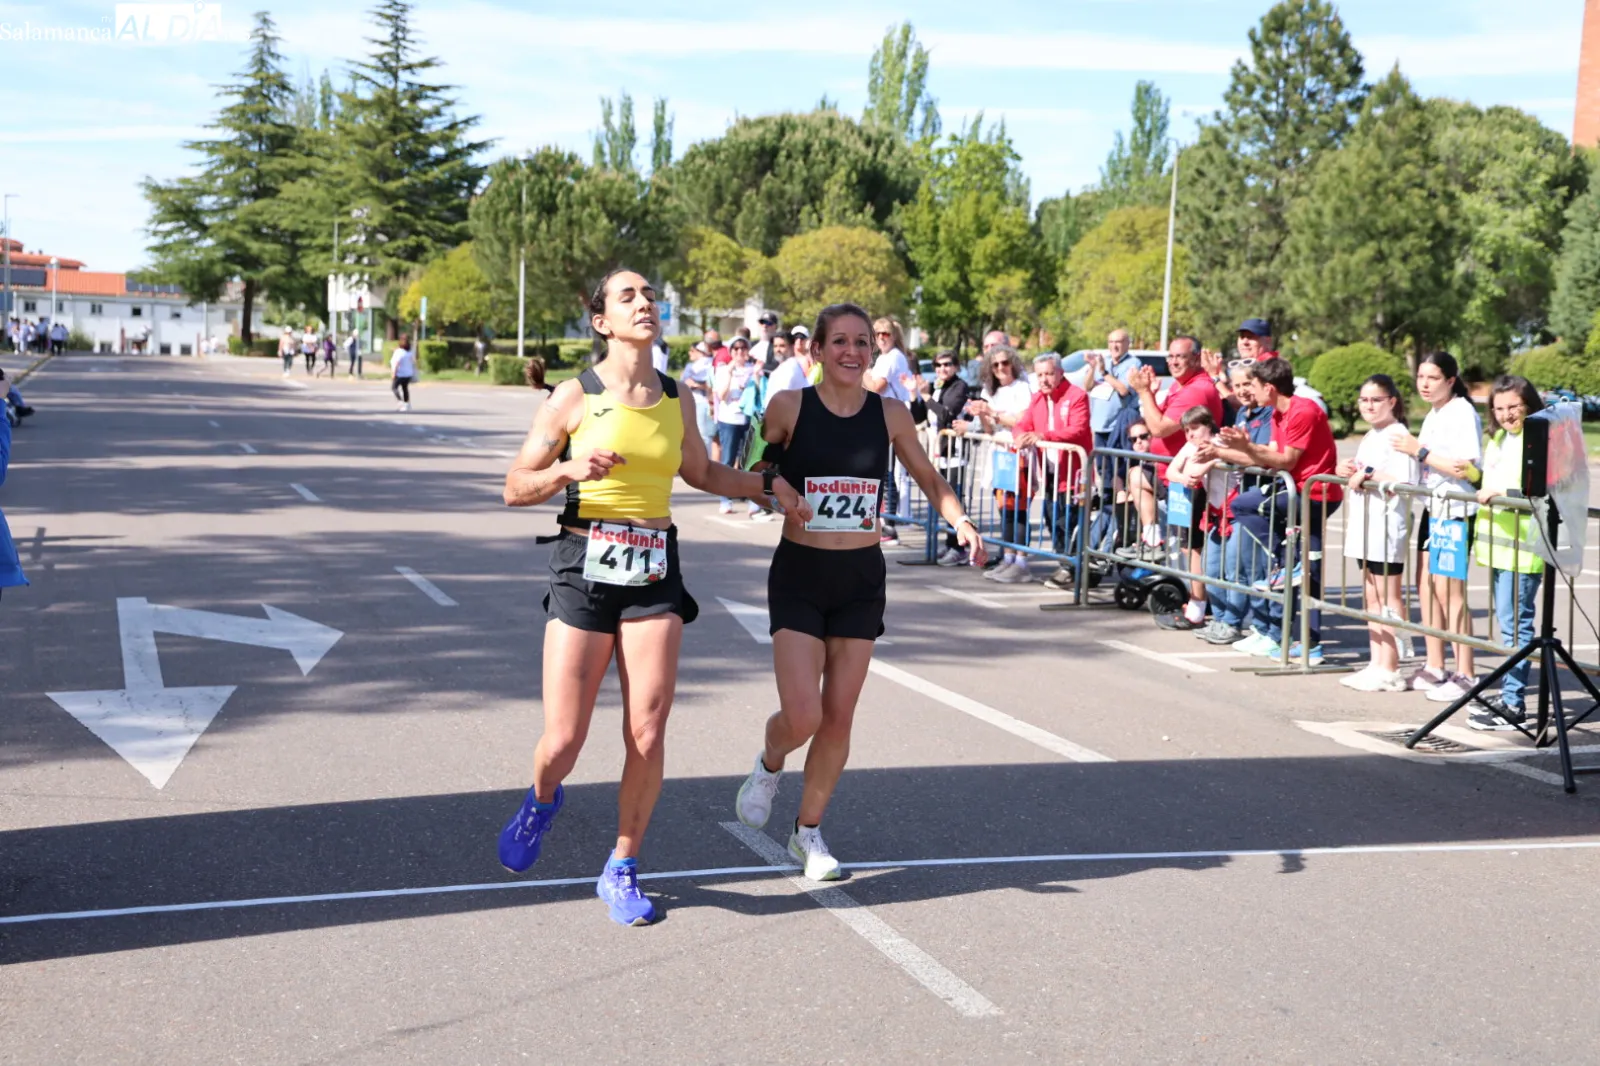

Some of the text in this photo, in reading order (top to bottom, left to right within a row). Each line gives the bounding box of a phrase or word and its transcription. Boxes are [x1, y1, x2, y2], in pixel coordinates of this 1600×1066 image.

[807, 480, 877, 495] bedunia
[817, 495, 867, 519] 424
[591, 526, 665, 550] bedunia
[599, 544, 652, 574] 411
